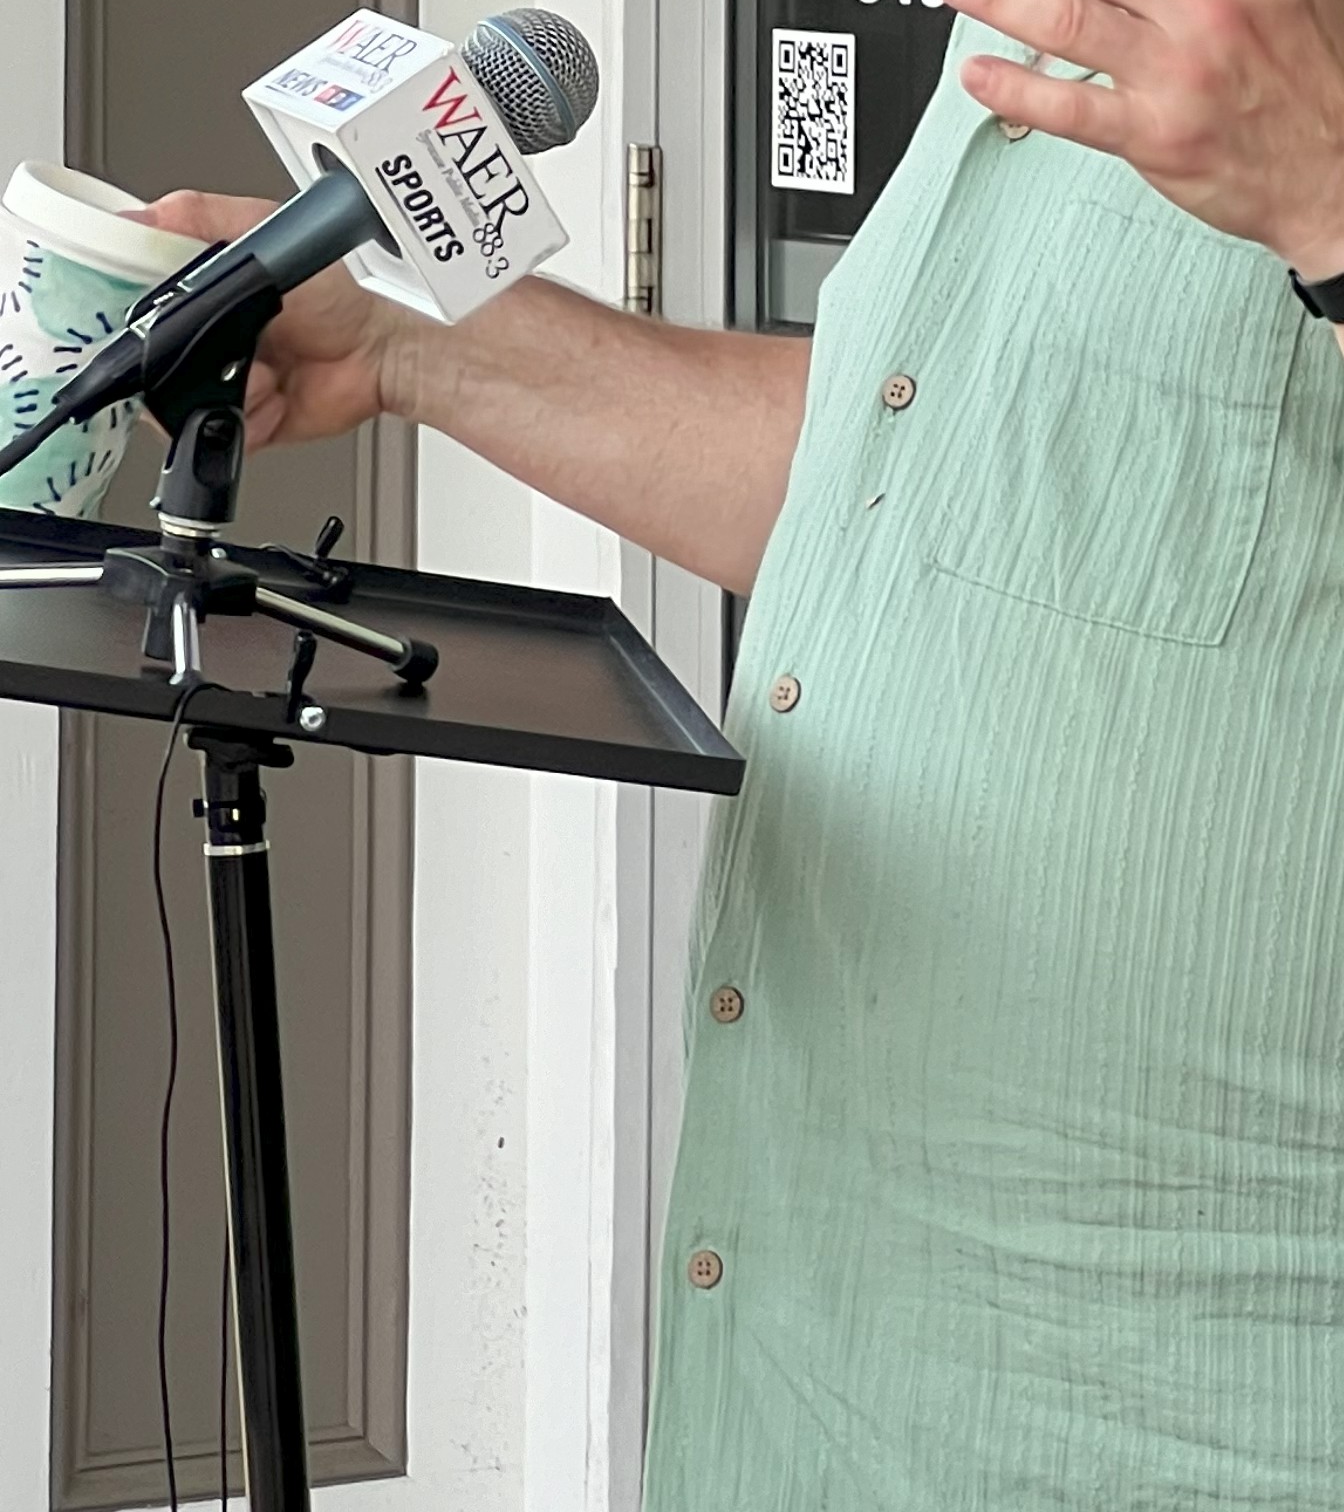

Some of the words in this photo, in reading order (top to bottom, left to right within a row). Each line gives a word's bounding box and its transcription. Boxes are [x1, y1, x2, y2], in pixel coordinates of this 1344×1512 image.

[327, 19, 418, 72] WAER
[422, 66, 530, 239] WAER
[381, 154, 465, 263] SPORTS
[472, 222, 510, 279] 88.3
